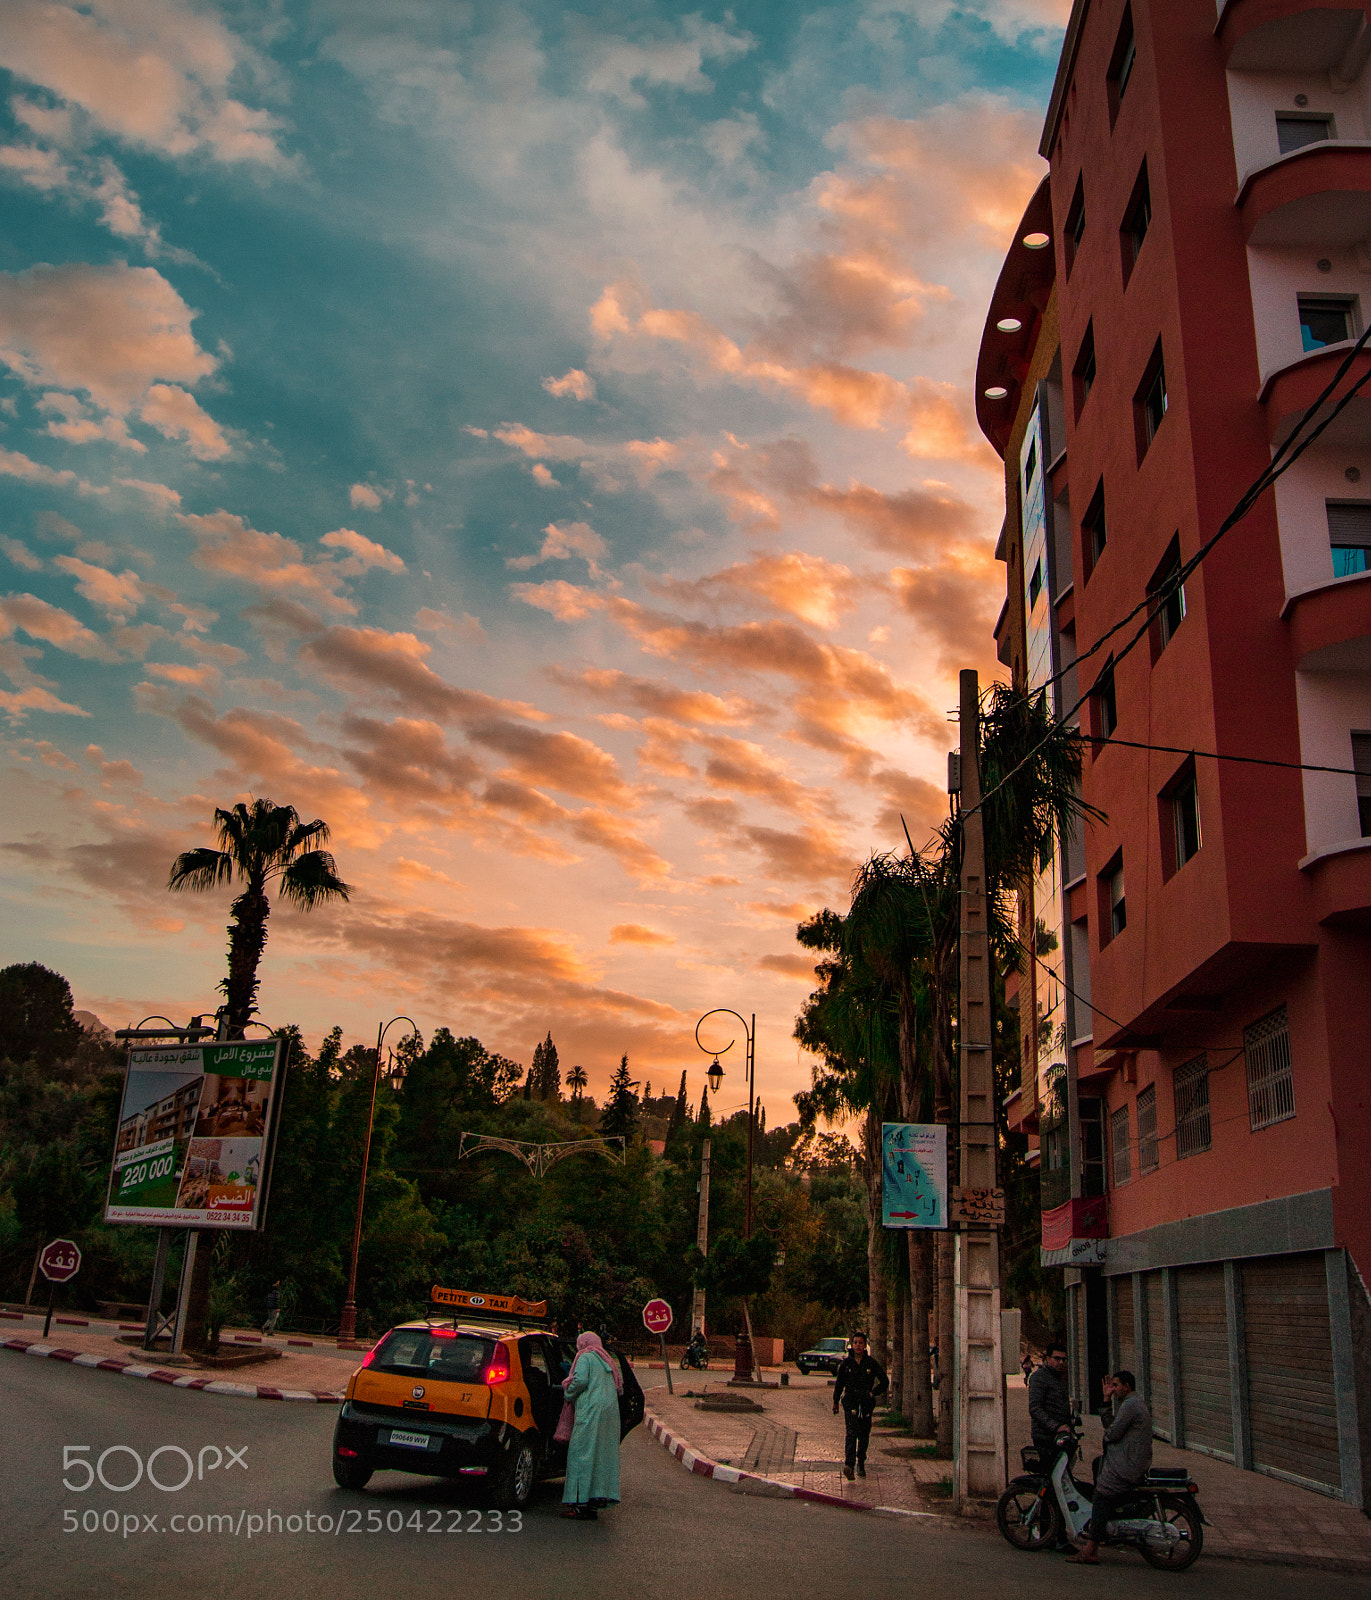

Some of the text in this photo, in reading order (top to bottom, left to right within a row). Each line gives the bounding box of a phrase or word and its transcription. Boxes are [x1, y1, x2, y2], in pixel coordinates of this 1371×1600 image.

[180, 1050, 200, 1061] شقق
[239, 1046, 275, 1062] مشروع
[240, 1065, 257, 1076] ملال
[122, 1155, 173, 1188] 220 000
[223, 1212, 231, 1221] 34
[232, 1213, 240, 1221] 34
[241, 1213, 250, 1222] 35
[46, 1250, 75, 1269] قف
[438, 1292, 467, 1304] PETITE
[489, 1298, 508, 1309] TAXI
[648, 1309, 668, 1323] قف
[461, 1393, 472, 1402] 17
